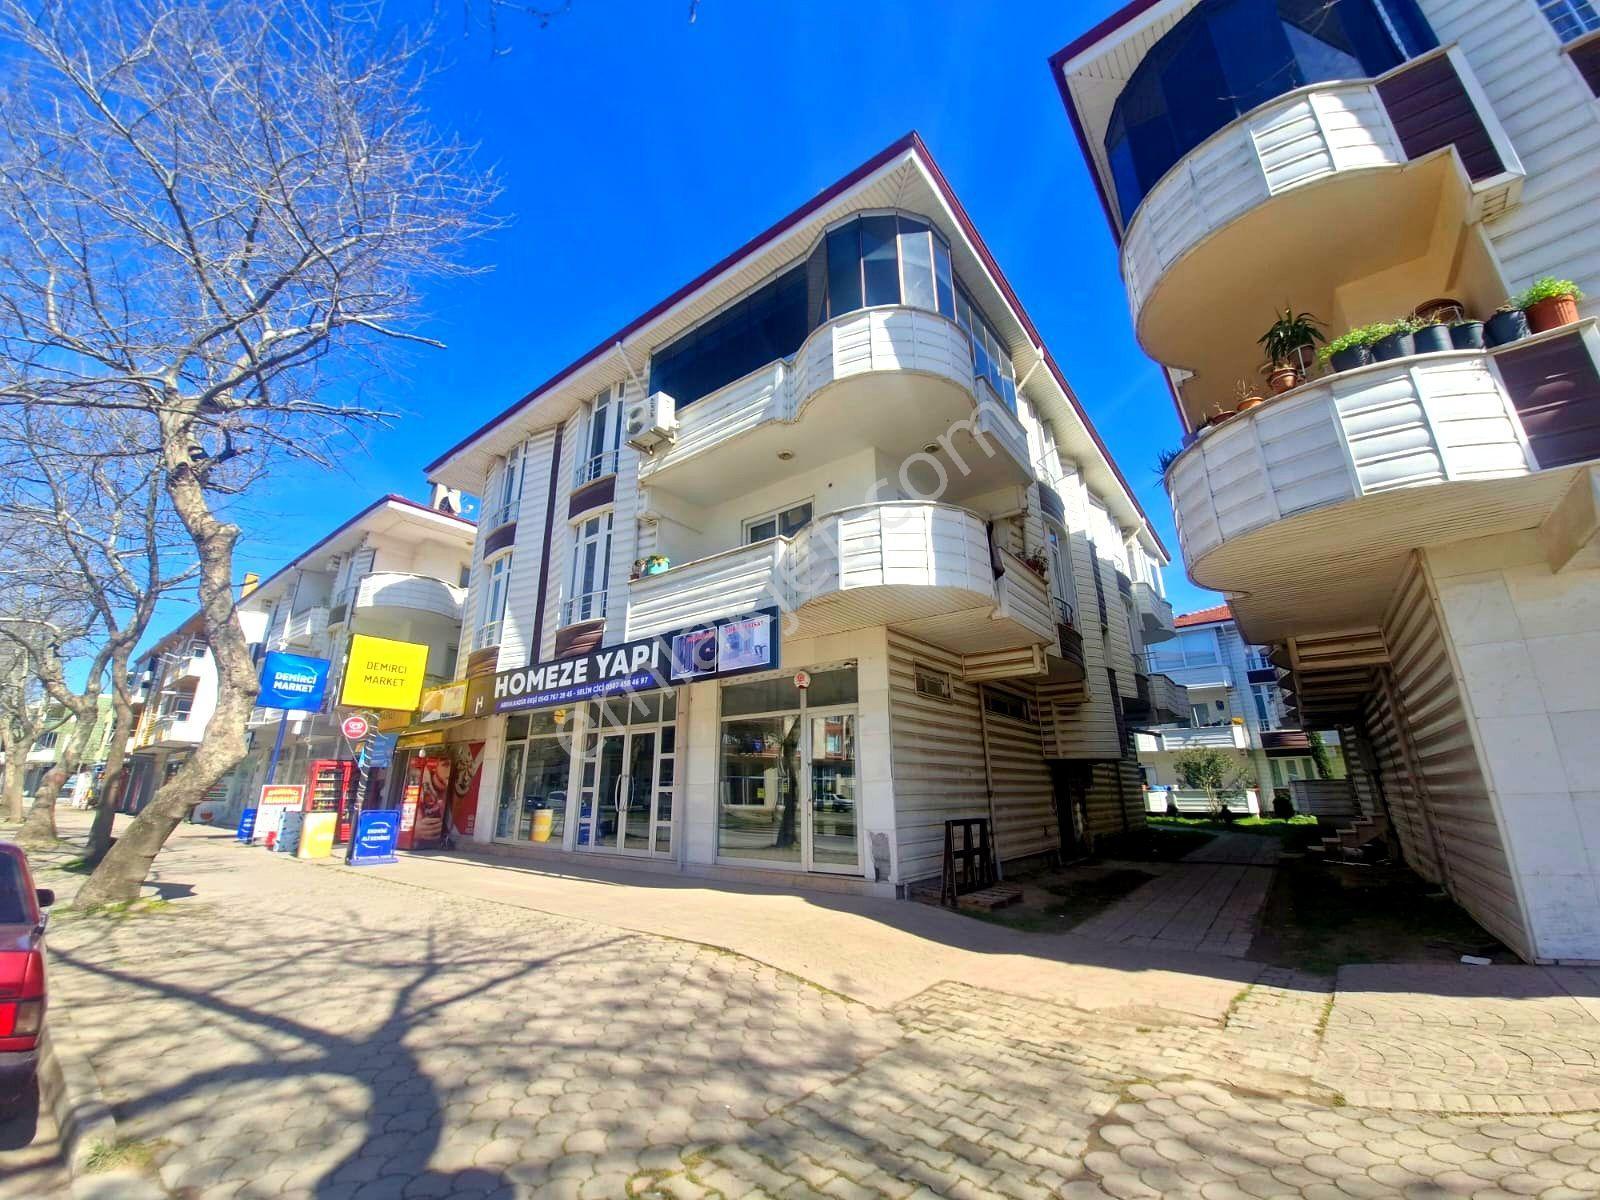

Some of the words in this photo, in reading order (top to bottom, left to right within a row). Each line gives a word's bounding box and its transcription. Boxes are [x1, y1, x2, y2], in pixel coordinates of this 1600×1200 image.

[494, 657, 589, 698] HOMEZE
[596, 641, 659, 679] YAPI
[273, 680, 315, 693] MARKET
[363, 675, 405, 687] MARKET
